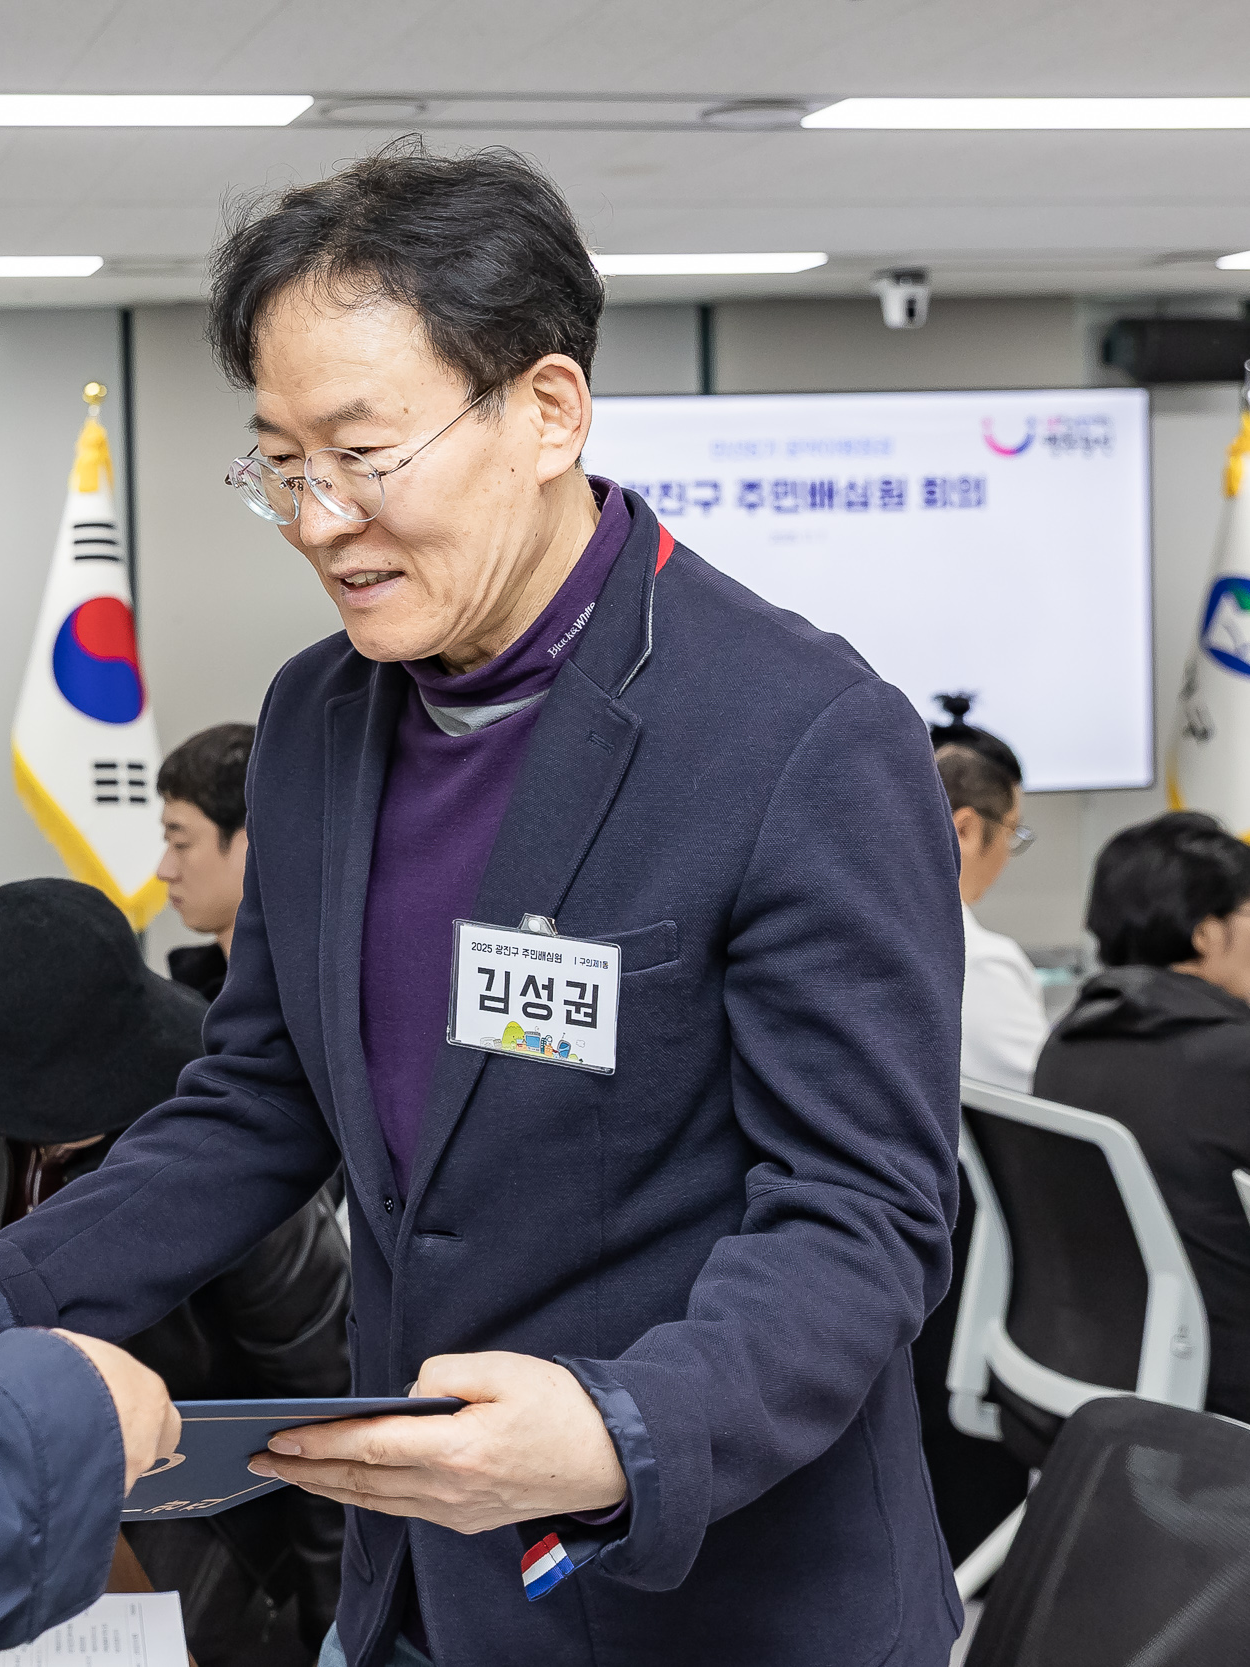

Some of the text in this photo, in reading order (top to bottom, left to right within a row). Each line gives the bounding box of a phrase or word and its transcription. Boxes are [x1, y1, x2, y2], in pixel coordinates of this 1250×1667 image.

[738, 478, 904, 516] 주민배심원
[547, 602, 596, 659] Black&White
[471, 941, 563, 964] 2025 광진구 주민배심원
[477, 966, 600, 1030] 김성권
